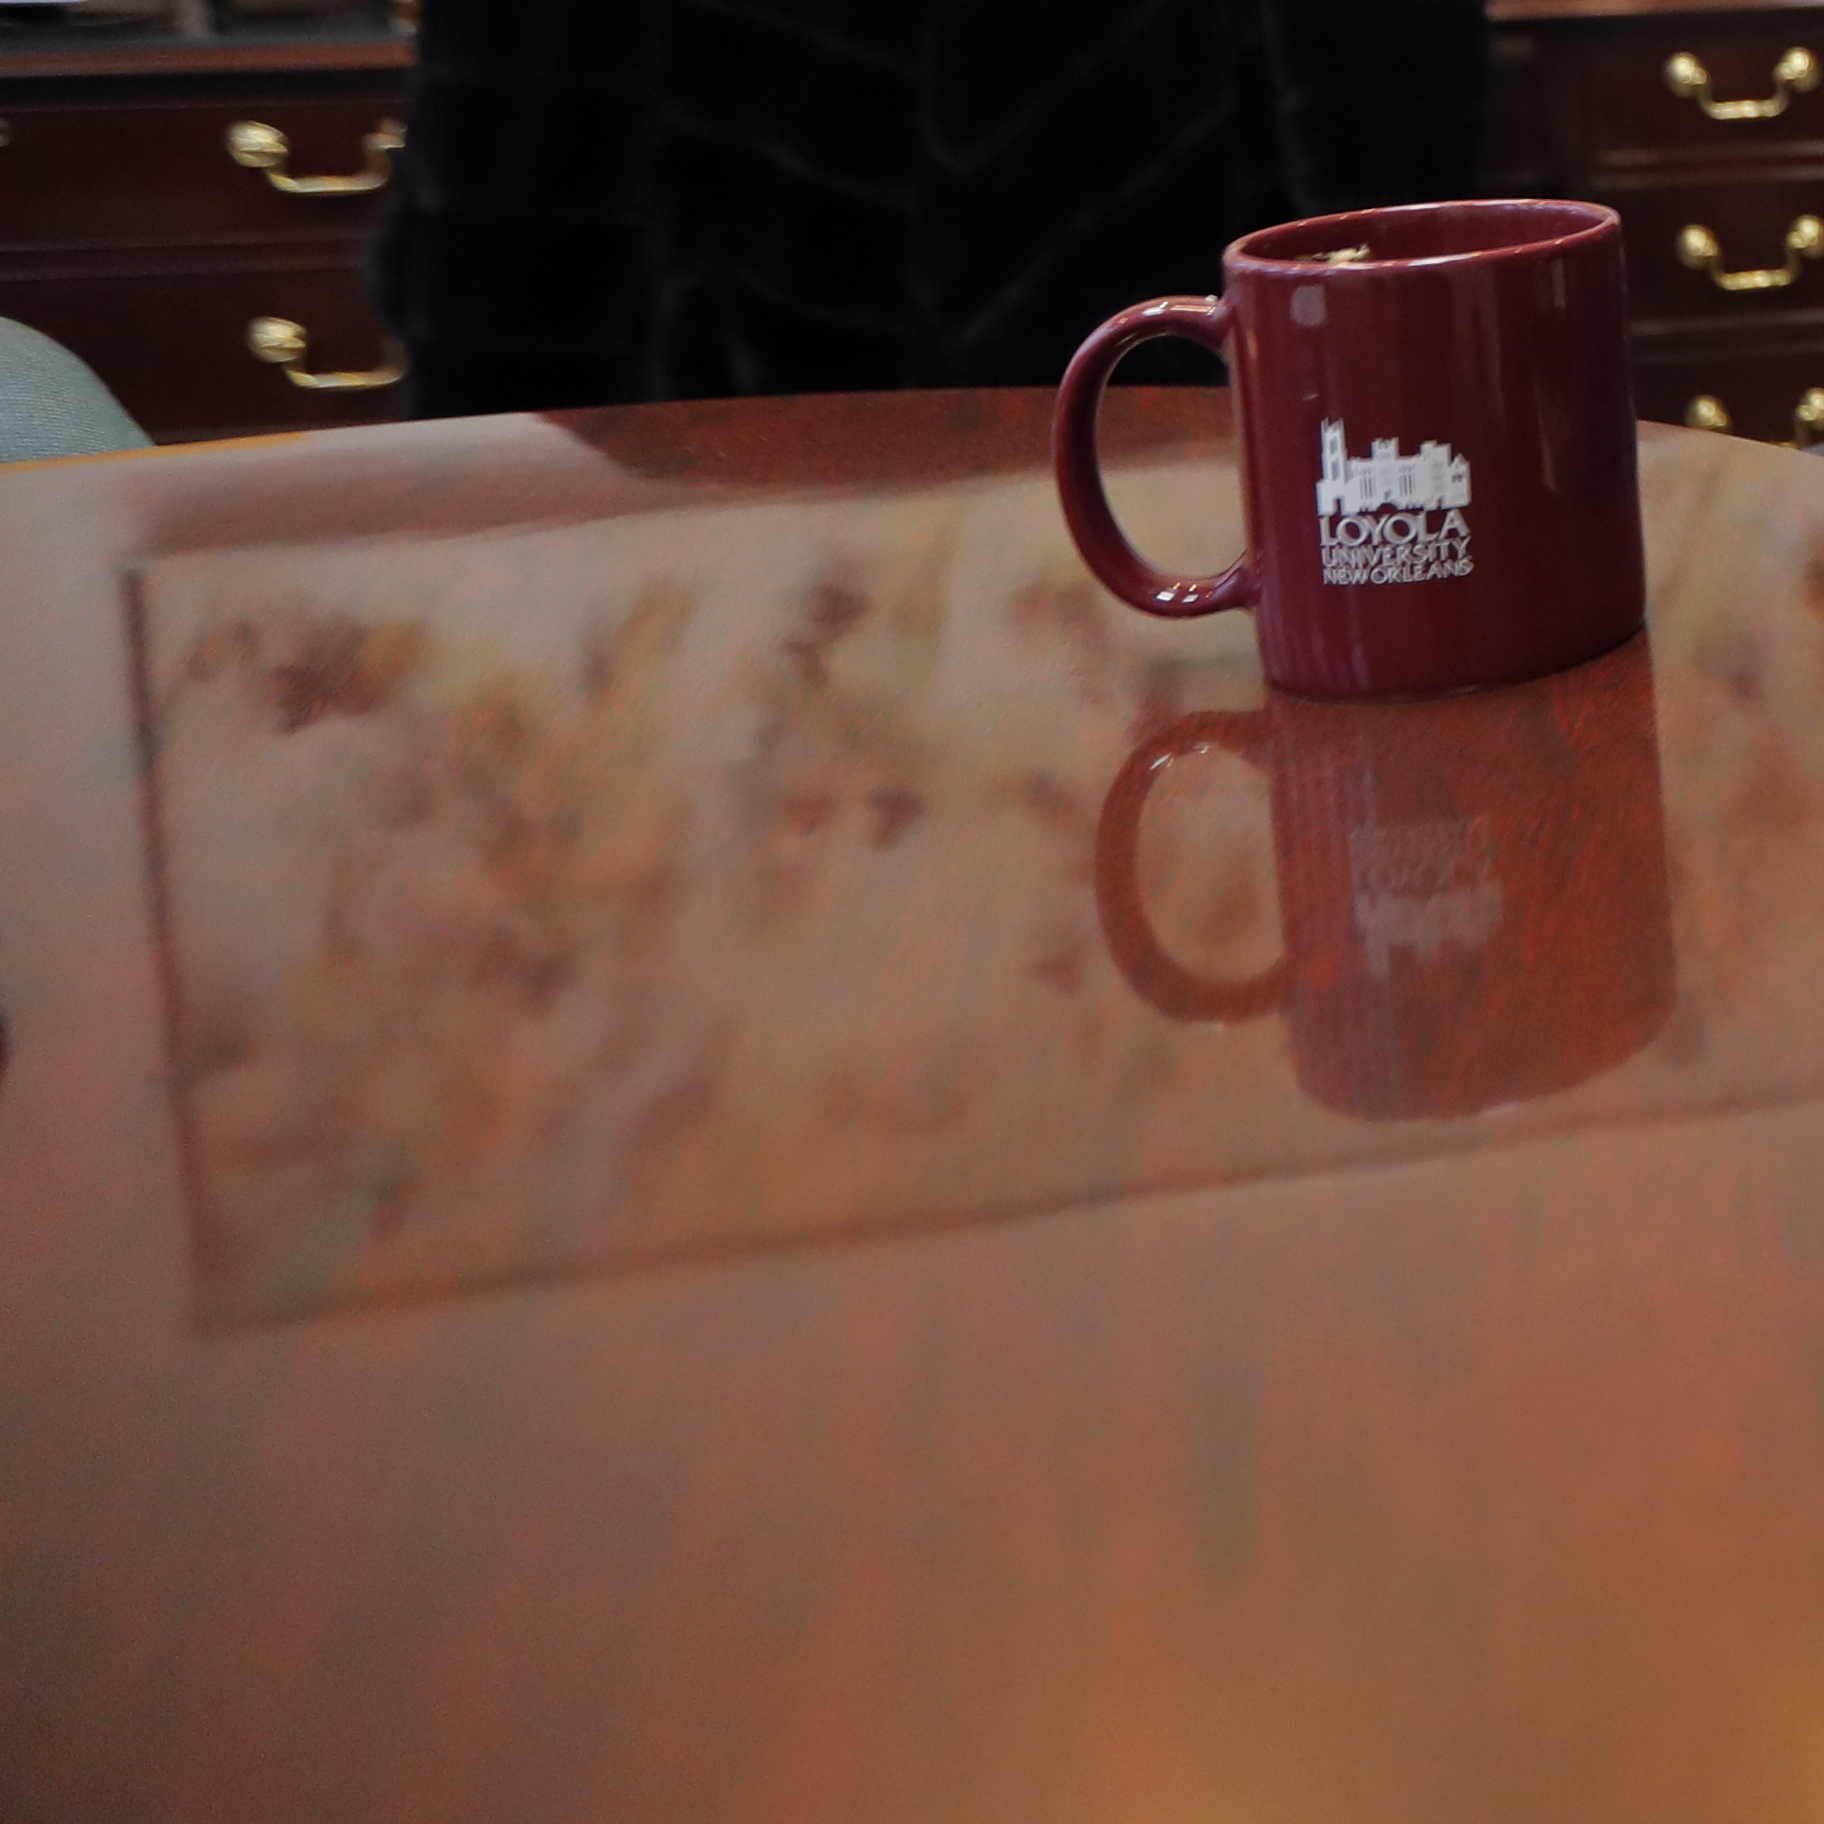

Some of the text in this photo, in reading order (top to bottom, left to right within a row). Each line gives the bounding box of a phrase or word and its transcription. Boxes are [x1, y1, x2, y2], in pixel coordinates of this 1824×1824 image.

[1319, 507, 1471, 547] LOYOLA
[1321, 536, 1471, 567] UNIVERSITY
[1323, 555, 1474, 585] NEW ORLEANS
